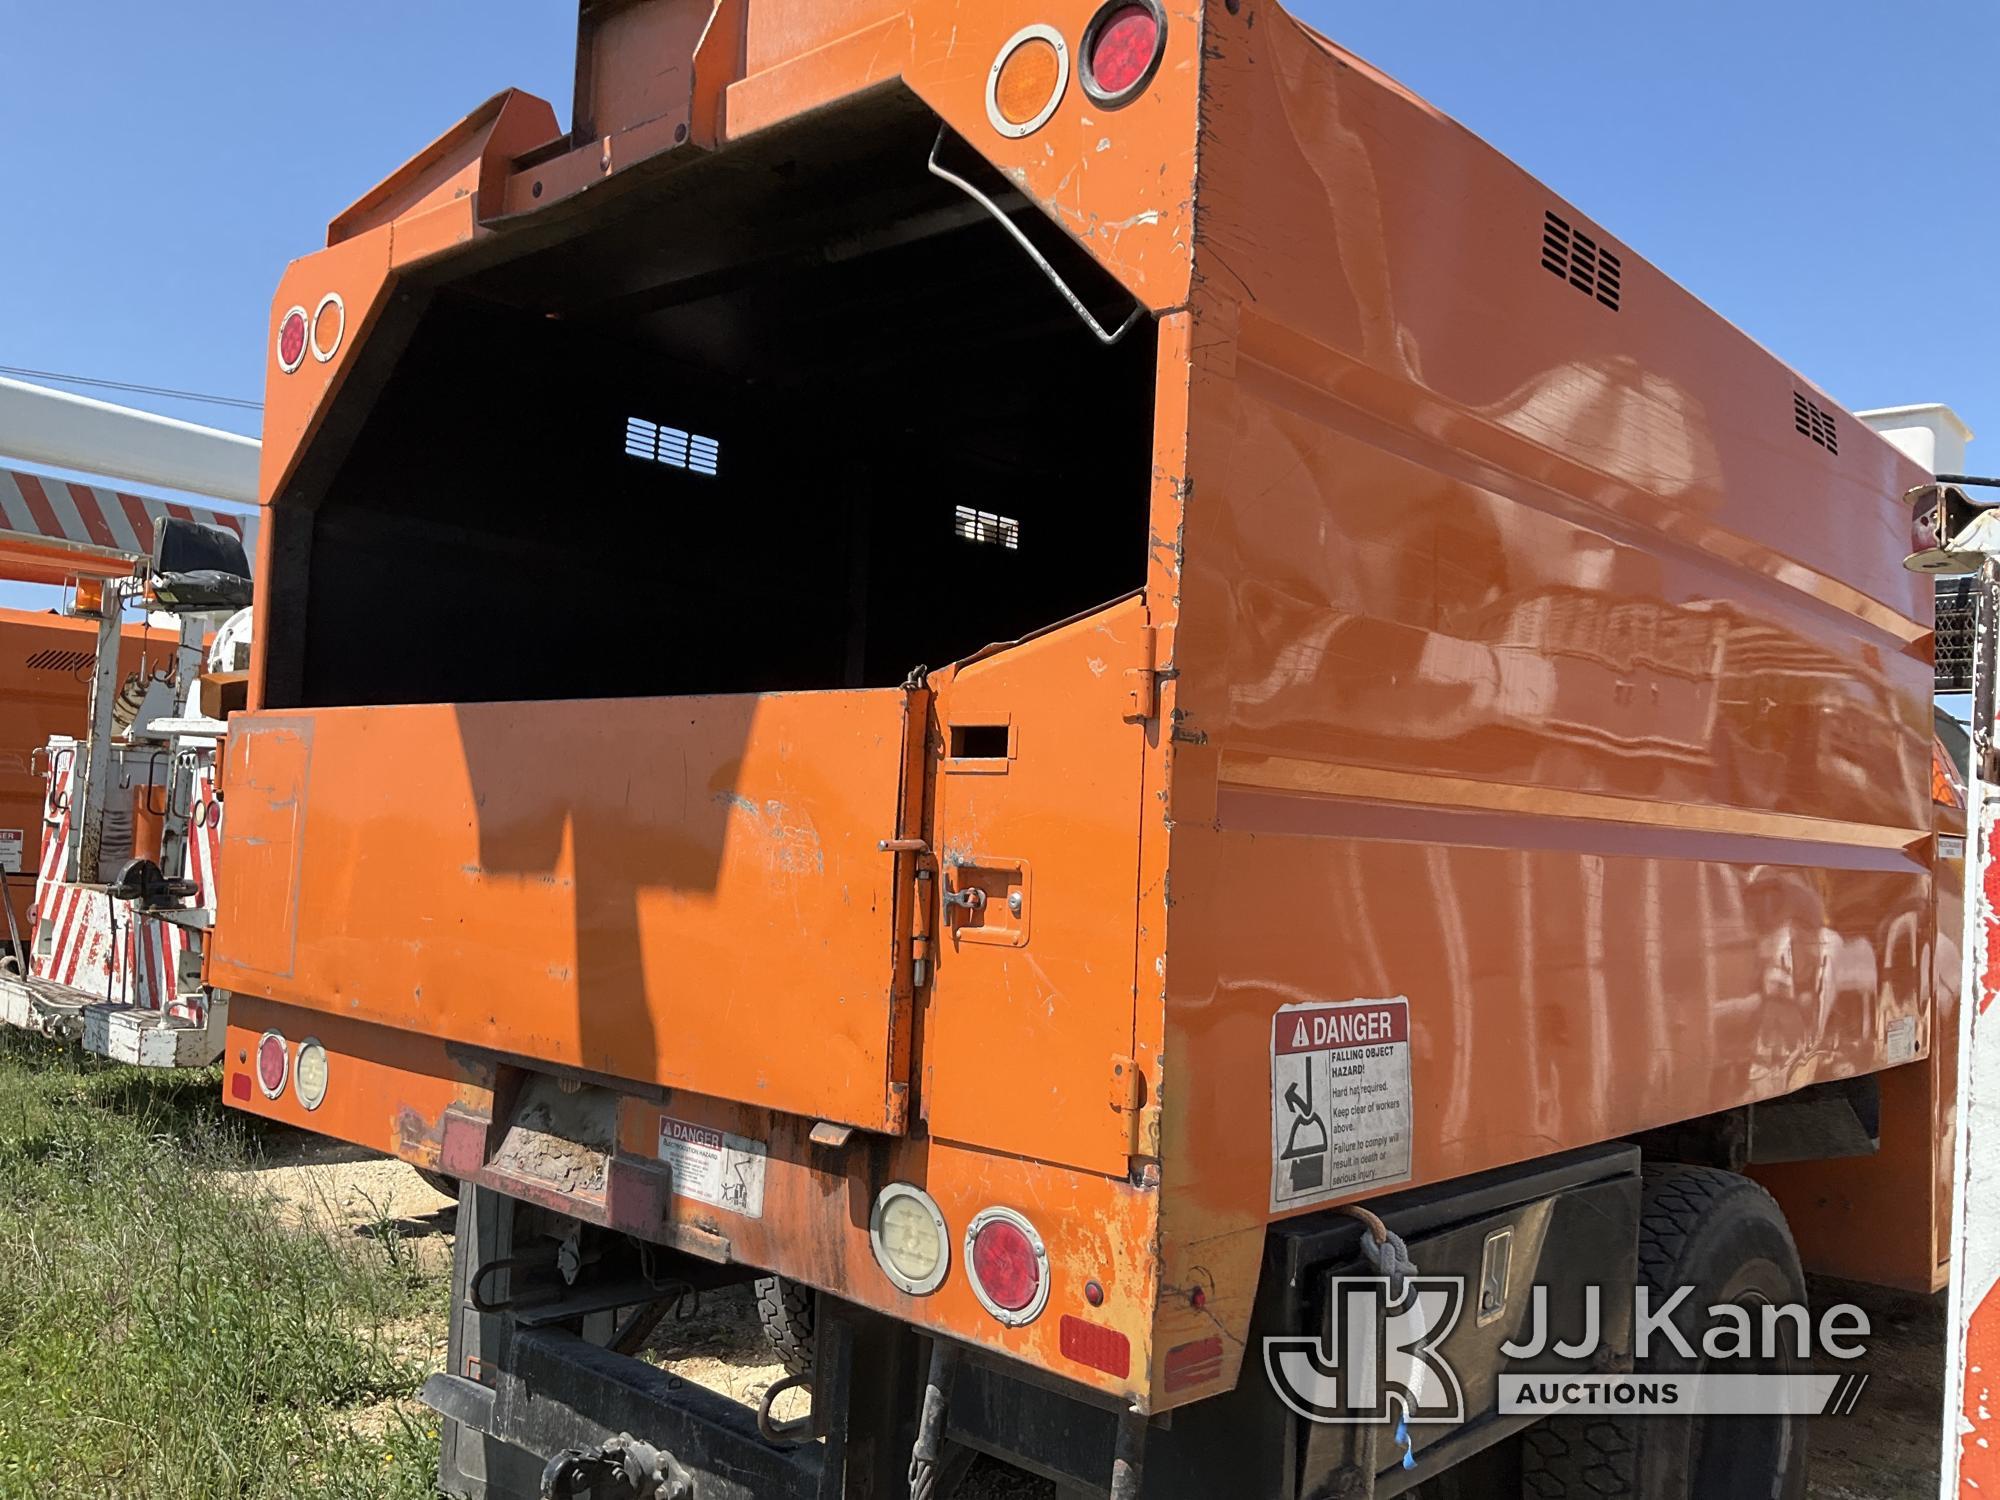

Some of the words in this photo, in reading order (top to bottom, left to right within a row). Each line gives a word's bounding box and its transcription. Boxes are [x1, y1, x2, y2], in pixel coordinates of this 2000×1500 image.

[1314, 1012, 1391, 1045] DANGER
[1332, 1048, 1363, 1062] FALLING
[1365, 1046, 1394, 1058] OBJECT
[1332, 1064, 1365, 1078] HAZARD!
[1332, 1085, 1347, 1098] Hard
[1349, 1084, 1359, 1095] hat
[1360, 1080, 1388, 1095] required.
[1332, 1106, 1349, 1119] Keep
[1351, 1104, 1366, 1115] clear
[1367, 1102, 1374, 1113] of
[1375, 1100, 1400, 1110] workers
[673, 1123, 719, 1149] DANGER
[1333, 1141, 1356, 1154] Failure
[1357, 1139, 1364, 1149] to
[1365, 1136, 1387, 1148] comply
[1389, 1132, 1399, 1143] will
[1333, 1157, 1352, 1169] result
[1360, 1151, 1378, 1164] death
[1332, 1173, 1356, 1186] serious
